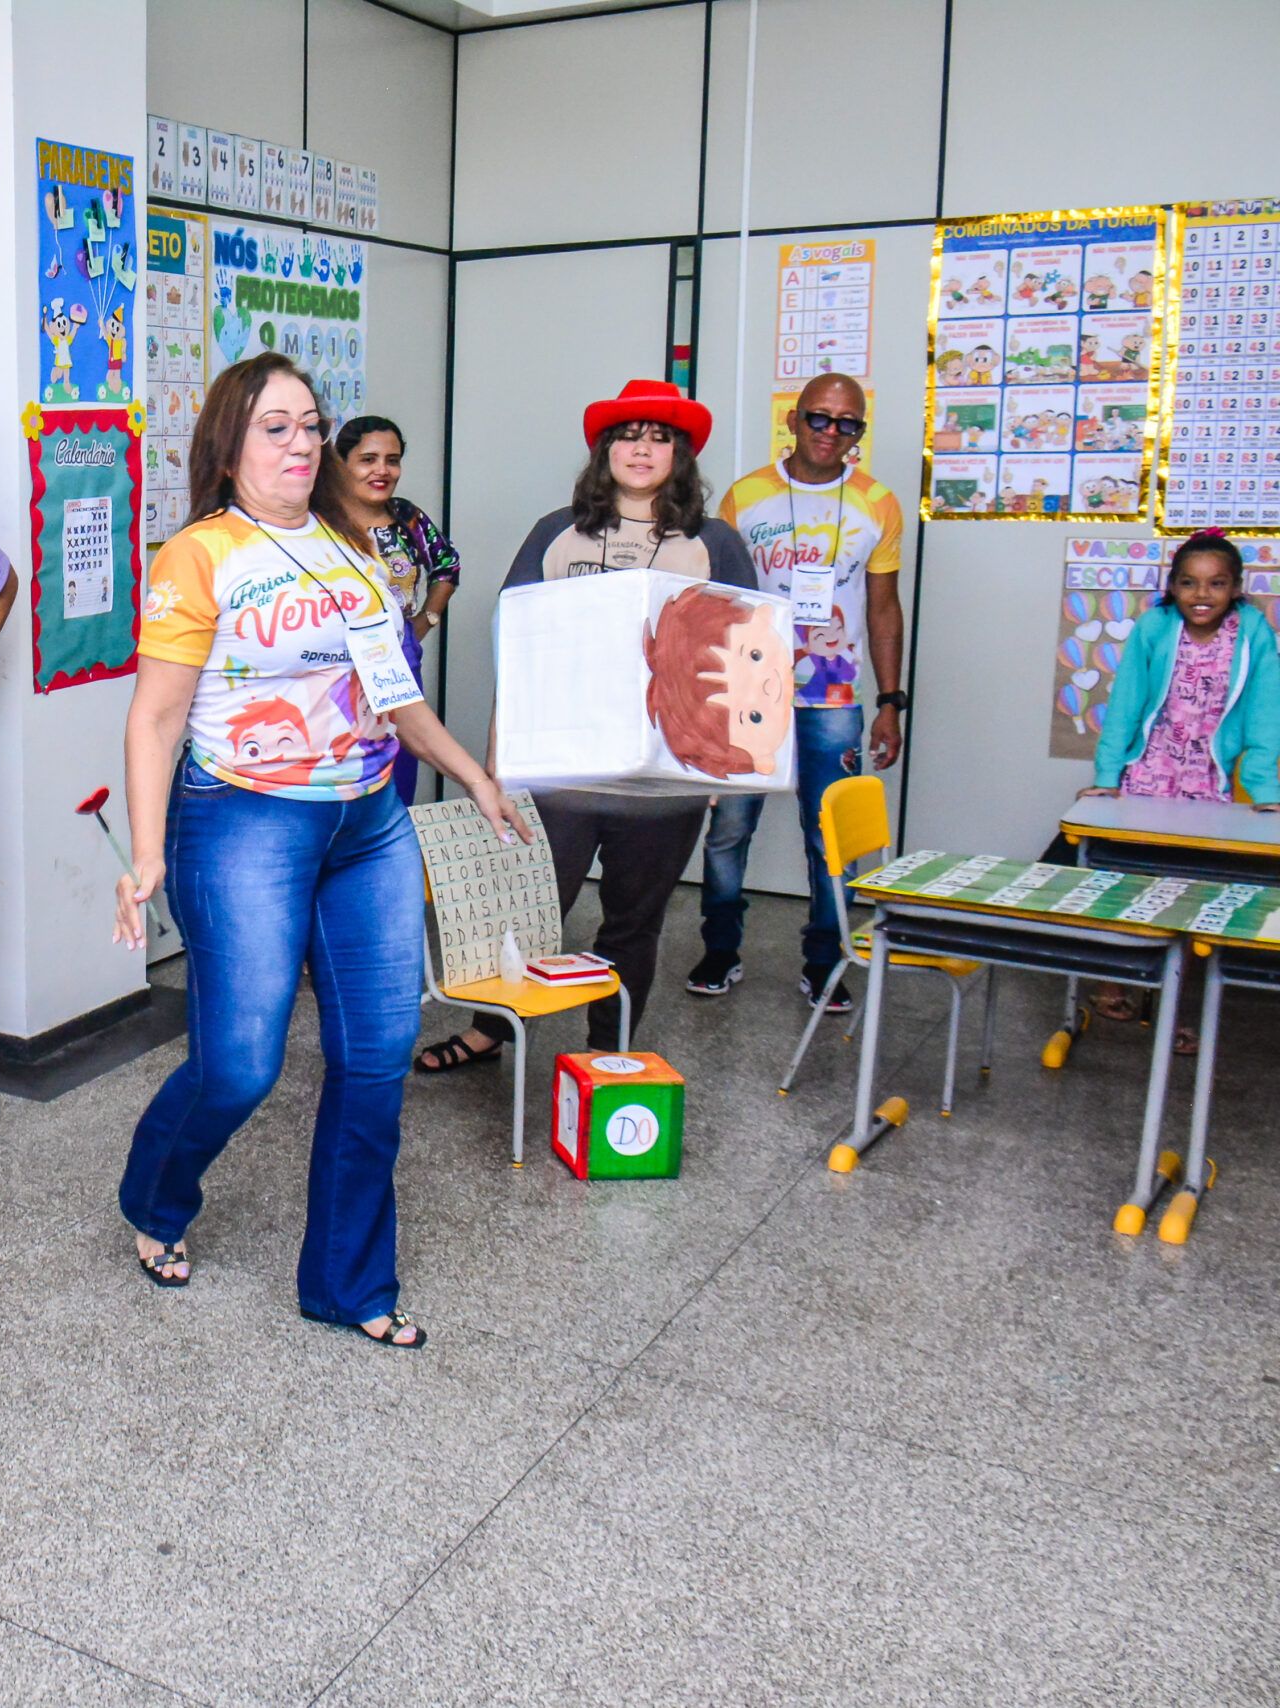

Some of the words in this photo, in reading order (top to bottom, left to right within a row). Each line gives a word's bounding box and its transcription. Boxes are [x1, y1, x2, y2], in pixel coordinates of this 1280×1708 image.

[157, 136, 166, 157] 2
[193, 146, 201, 167] 3
[220, 151, 228, 171] 4
[277, 150, 285, 169] 6
[301, 156, 310, 174] 7
[248, 159, 255, 177] 5
[325, 161, 332, 181] 8
[349, 207, 355, 226] 9
[943, 220, 1061, 239] COMBINADOS
[1065, 217, 1091, 231] DA
[1096, 215, 1158, 229] TURMA
[147, 228, 182, 259] ETO
[1190, 233, 1198, 243] 0
[1214, 232, 1221, 242] 1
[1237, 231, 1245, 241] 2
[1262, 229, 1270, 240] 3
[214, 226, 258, 272] NÓS
[791, 246, 809, 260] As
[814, 243, 864, 261] vogais
[1184, 262, 1200, 272] 10
[1207, 260, 1223, 271] 11
[1231, 259, 1247, 269] 12
[1255, 258, 1272, 269] 13
[785, 270, 800, 286] A
[236, 275, 360, 322] PROTEGEMOS
[1182, 288, 1198, 298] 20
[1206, 287, 1221, 298] 21
[1229, 286, 1245, 297] 22
[1253, 285, 1269, 296] 23
[786, 293, 798, 309] E
[788, 315, 793, 331] I
[1181, 316, 1196, 326] 30
[1204, 315, 1219, 326] 31
[1227, 314, 1243, 325] 32
[1251, 313, 1268, 324] 33
[783, 337, 798, 353] O
[1179, 344, 1195, 354] 40
[1202, 343, 1217, 353] 41
[1226, 342, 1242, 353] 42
[1249, 342, 1266, 352] 43
[782, 359, 796, 375] U
[1177, 371, 1192, 381] 50
[1201, 371, 1215, 381] 51
[1223, 370, 1240, 381] 52
[1247, 370, 1264, 380] 53
[1174, 399, 1191, 409] 60
[1198, 399, 1214, 409] 61
[1221, 399, 1237, 408] 62
[1245, 398, 1262, 408] 63
[1173, 426, 1189, 437] 70
[1197, 426, 1212, 436] 71
[1220, 426, 1236, 436] 72
[1244, 426, 1260, 436] 73
[55, 438, 116, 466] Calendário
[1171, 453, 1187, 463] 80
[1195, 453, 1210, 463] 81
[1218, 453, 1234, 463] 82
[1241, 453, 1258, 463] 83
[1169, 480, 1185, 490] 90
[1192, 480, 1208, 490] 91
[1216, 480, 1232, 490] 92
[1240, 480, 1256, 490] 93
[1264, 480, 1280, 490] 94
[607, 541, 643, 549] EGENDARY
[1071, 540, 1161, 560] VAMOS
[753, 539, 822, 576] Verão
[1067, 566, 1158, 588] ESCOLA
[258, 592, 273, 608] de
[235, 588, 364, 648] Verão
[300, 649, 353, 663] aprendi
[600, 1058, 639, 1071] DA
[614, 1116, 652, 1146] DO
